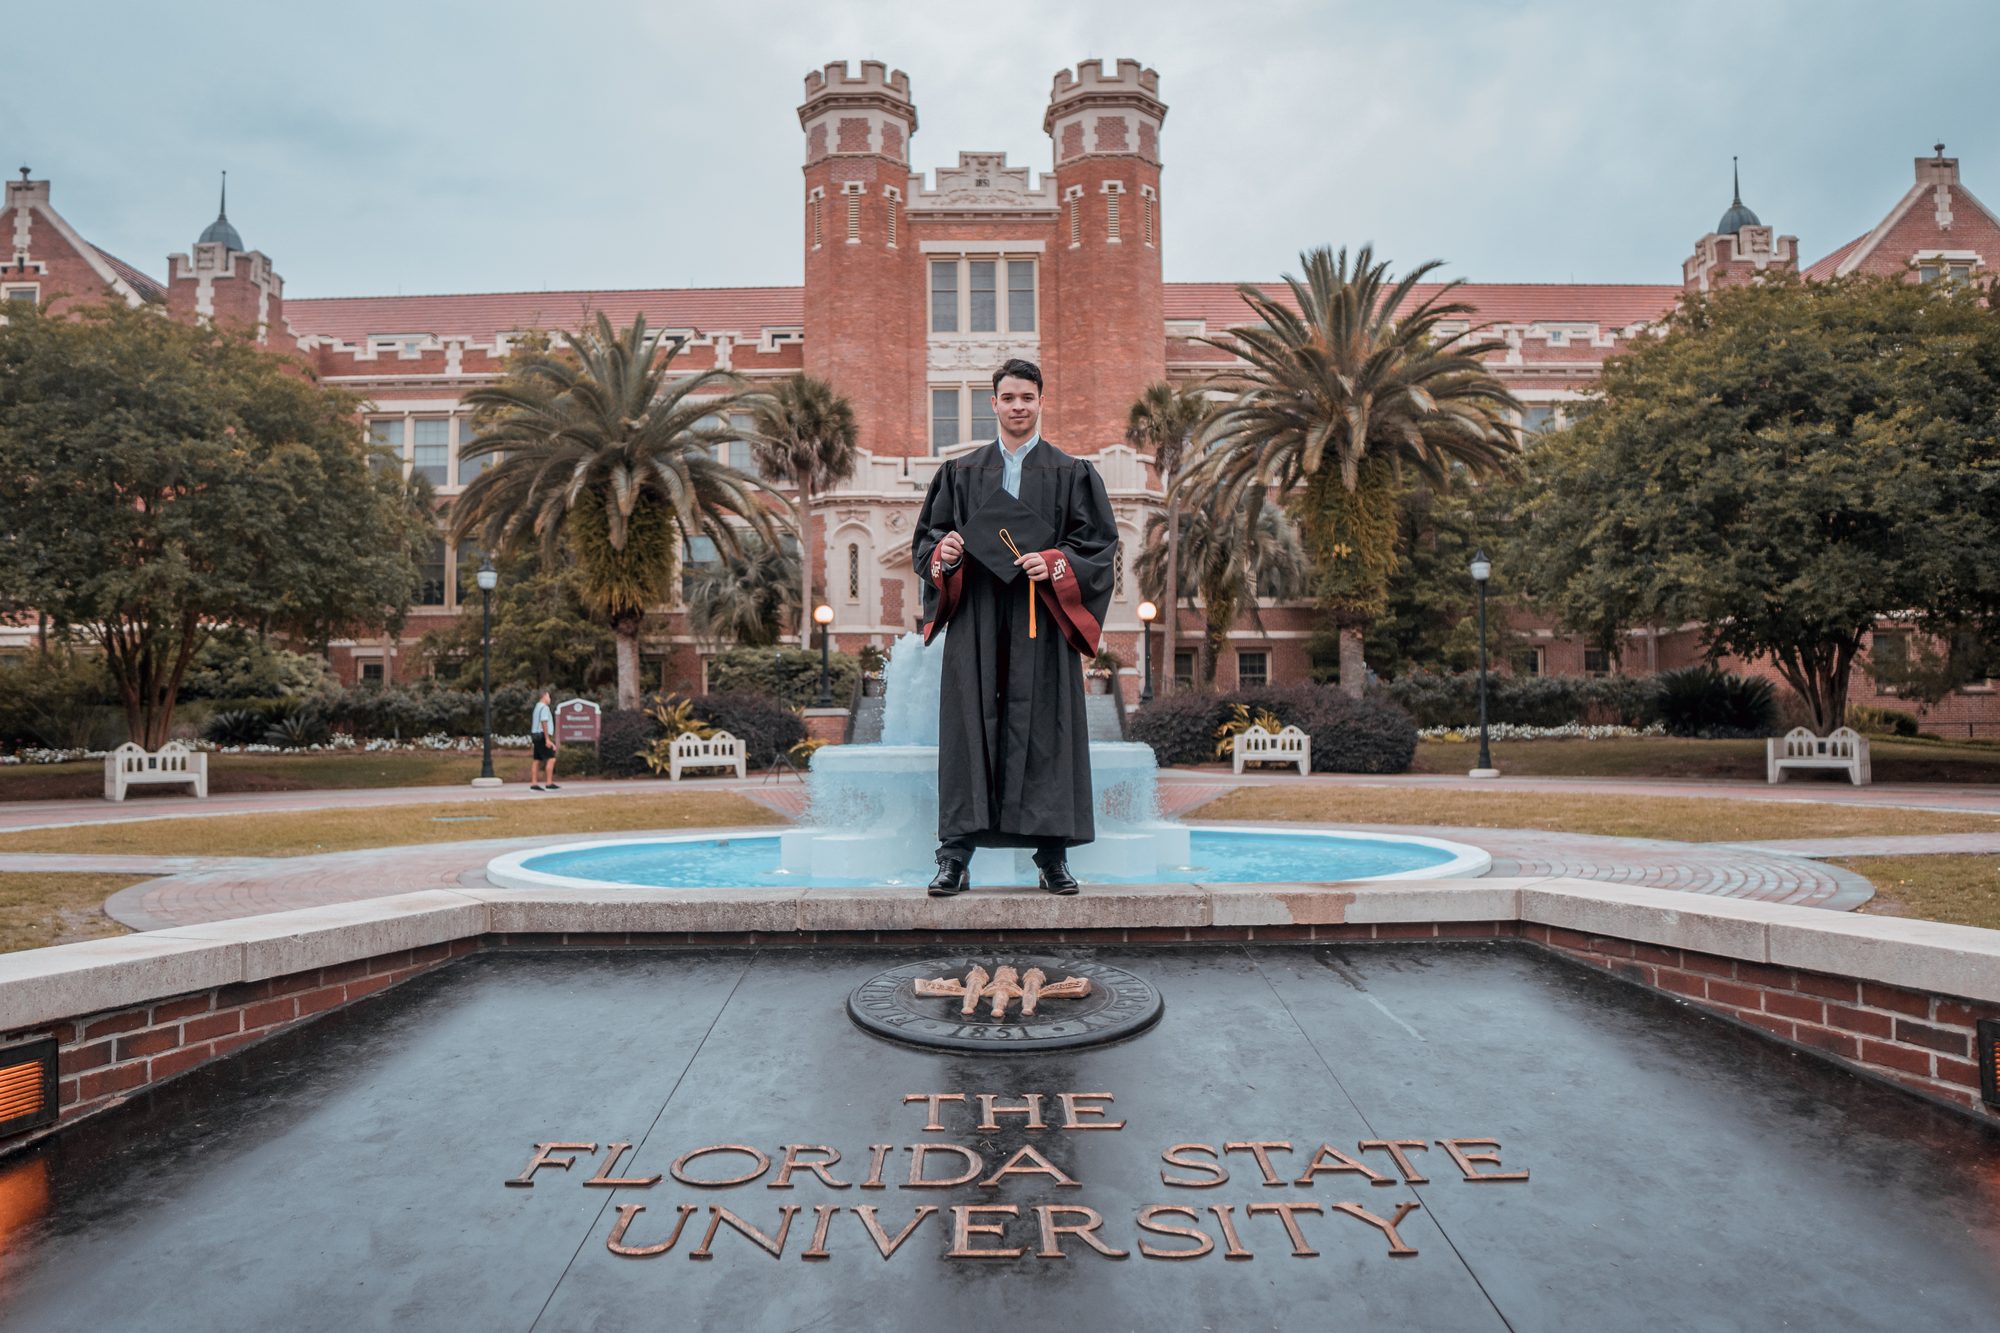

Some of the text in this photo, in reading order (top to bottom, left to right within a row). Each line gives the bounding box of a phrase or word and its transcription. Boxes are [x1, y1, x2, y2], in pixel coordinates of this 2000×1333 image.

[1053, 558, 1066, 581] FSU
[947, 1025, 1036, 1039] 1851
[903, 1092, 1127, 1132] THE
[504, 1138, 1530, 1188] FLORIDA STATE
[606, 1202, 1421, 1261] UNIVERSITY
